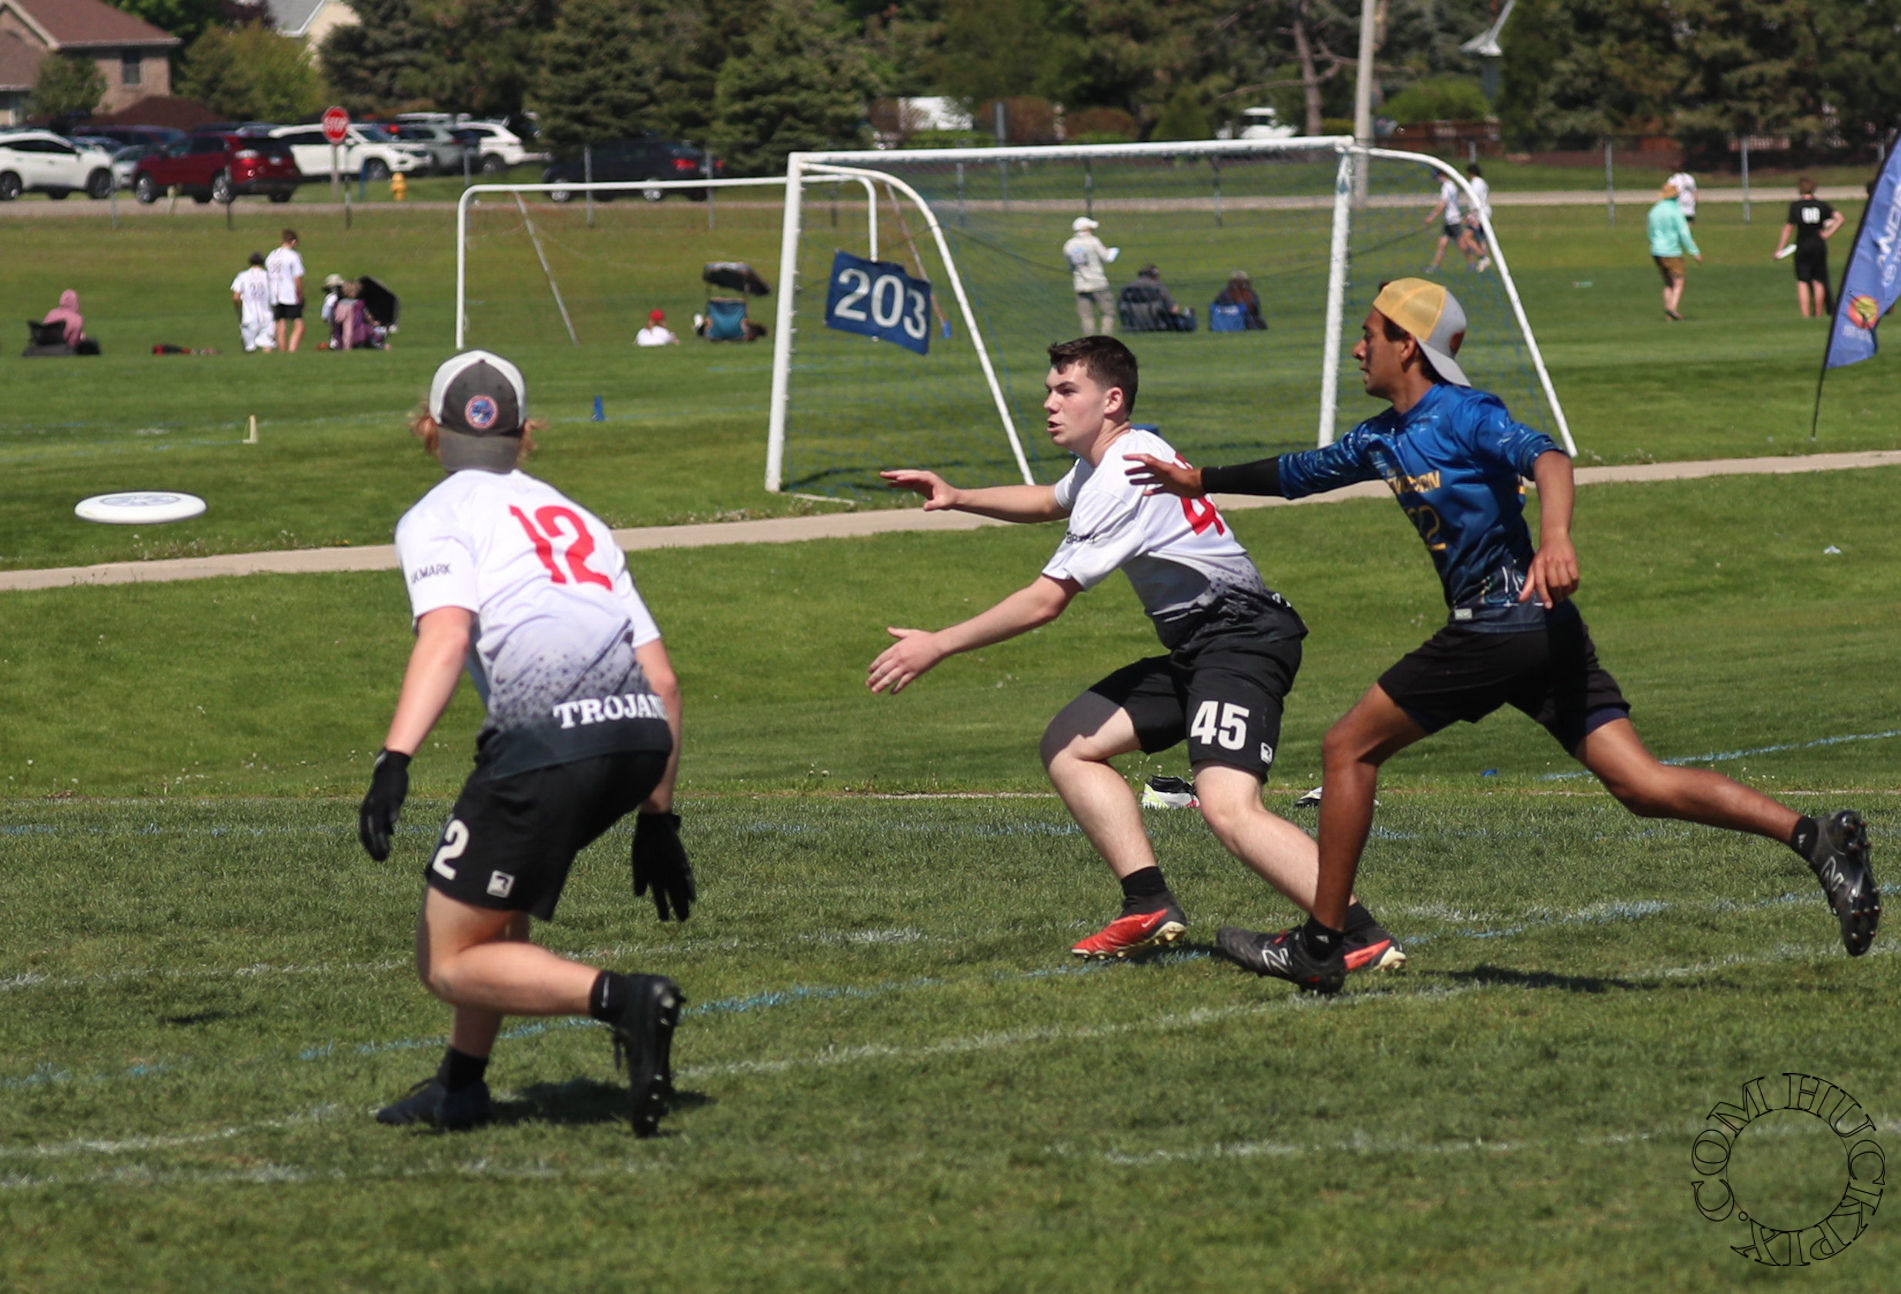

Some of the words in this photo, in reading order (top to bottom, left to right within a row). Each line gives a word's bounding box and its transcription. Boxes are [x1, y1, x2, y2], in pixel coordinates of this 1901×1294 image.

[834, 268, 926, 340] 203
[508, 505, 613, 592] 12
[1190, 700, 1250, 751] 45
[432, 819, 469, 880] 2
